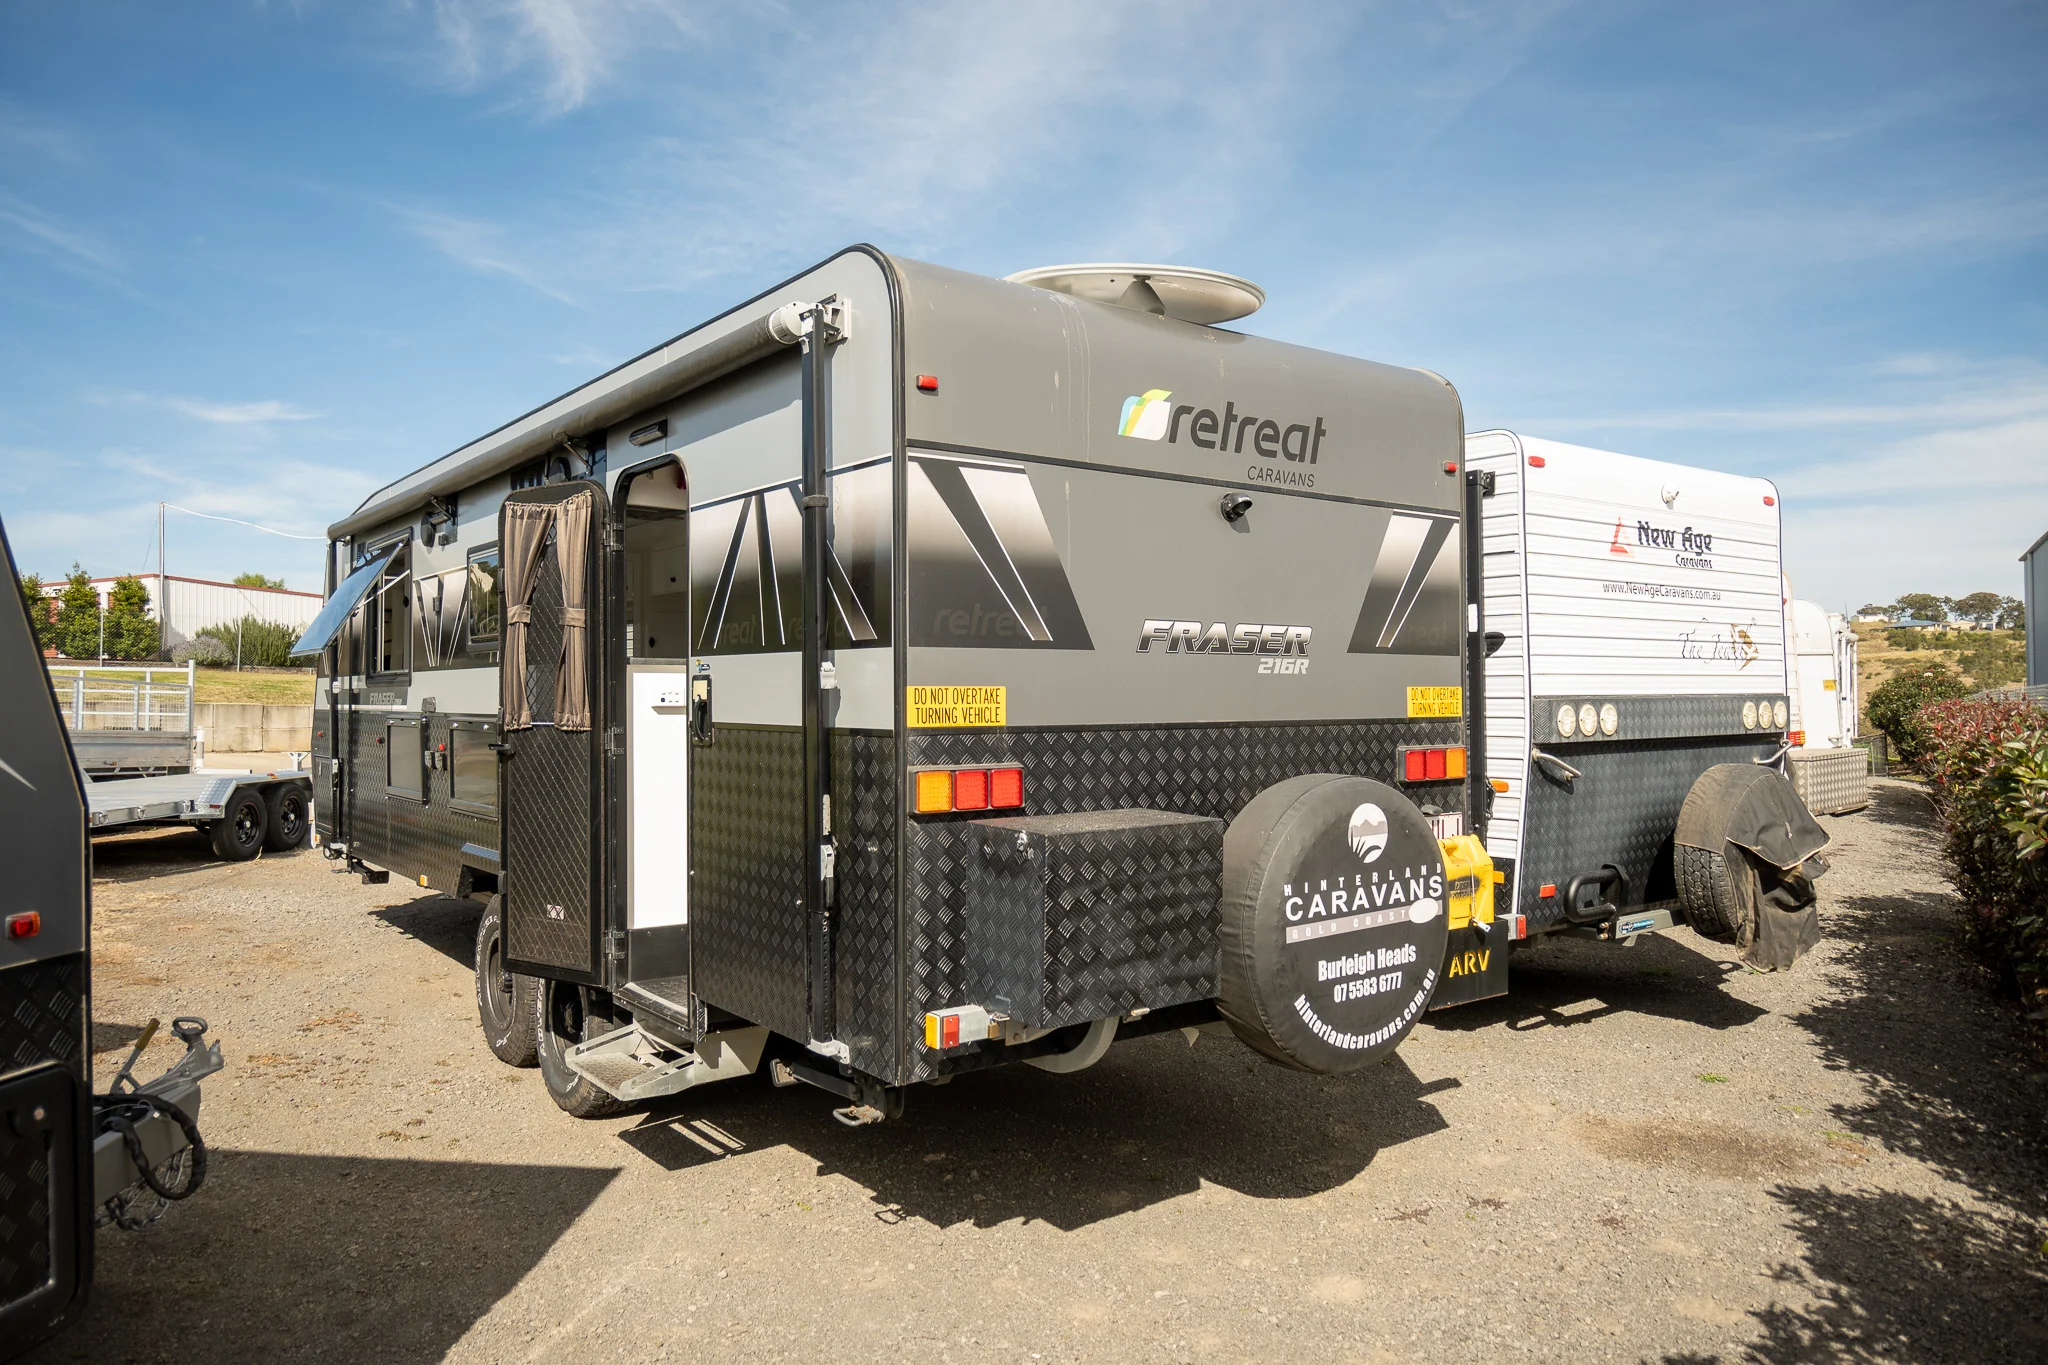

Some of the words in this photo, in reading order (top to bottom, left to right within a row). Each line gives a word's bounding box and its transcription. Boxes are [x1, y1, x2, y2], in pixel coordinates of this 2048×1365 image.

[1169, 401, 1326, 465] retreat
[1247, 465, 1315, 488] CARAVANS
[1637, 520, 1676, 548] New
[1681, 527, 1712, 556] Age
[1675, 554, 1713, 569] Caravans
[1602, 582, 1721, 600] www.NewAgeCaravans.com.au
[1136, 618, 1313, 656] FRASER
[1257, 658, 1309, 675] 216R
[914, 687, 927, 705] DO
[930, 687, 949, 705] NOT
[952, 687, 1001, 704] OVERTAKE
[915, 707, 958, 724] TURNING
[962, 706, 1000, 723] VEHICLE
[1283, 862, 1442, 896] HINTERLAND
[1285, 875, 1443, 921] CARAVANS
[1292, 922, 1338, 939] GOLD
[1353, 909, 1406, 928] COAST
[1318, 951, 1375, 981] Burleigh
[1377, 943, 1417, 969] Heads
[1449, 949, 1491, 979] ARV
[1333, 983, 1347, 1003] 07
[1348, 976, 1378, 1000] 5583
[1379, 971, 1403, 993] 6777
[1293, 968, 1436, 1050] hinterlandcaravans.com.au
